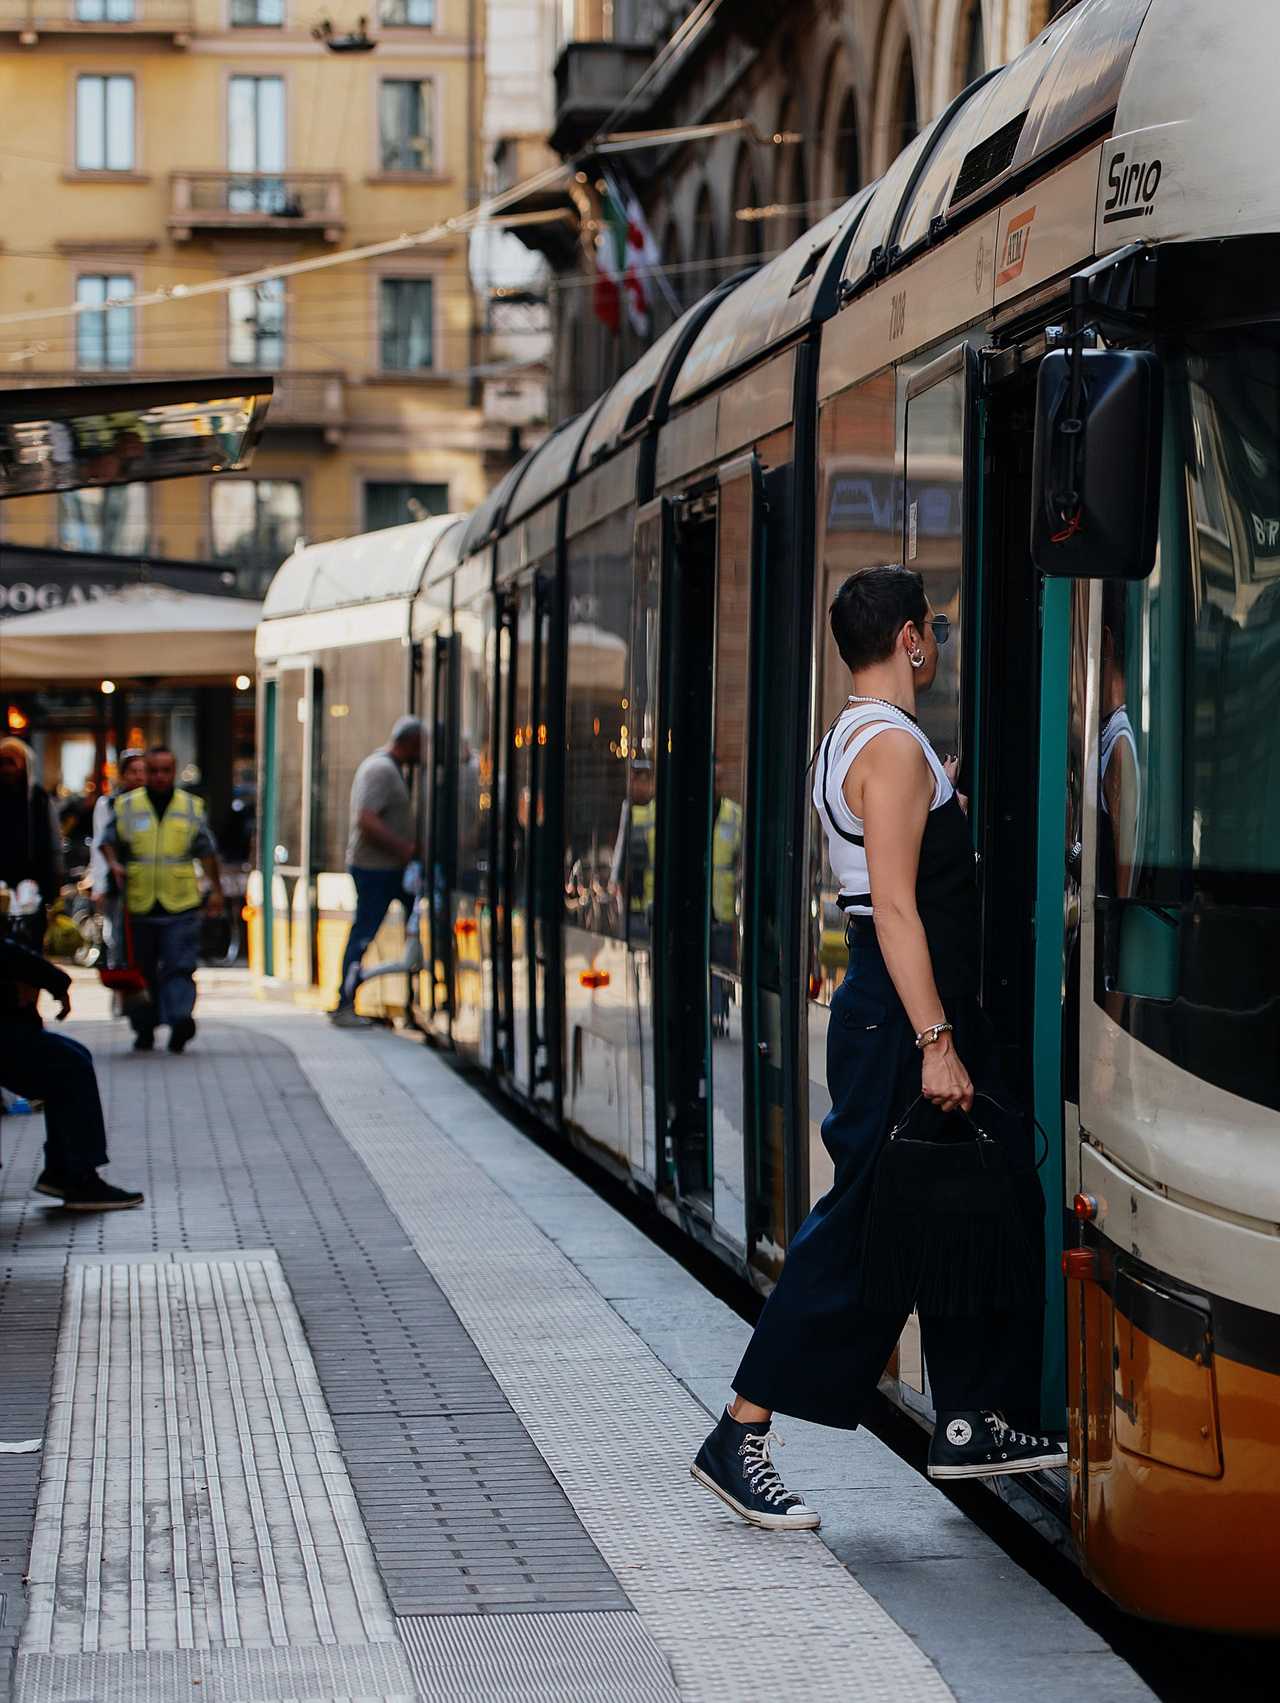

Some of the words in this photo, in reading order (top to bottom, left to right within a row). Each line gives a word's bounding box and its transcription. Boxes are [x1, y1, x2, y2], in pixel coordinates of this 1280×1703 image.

[1105, 152, 1161, 210] Sirio
[1007, 229, 1023, 267] ATM
[889, 290, 906, 341] 7108
